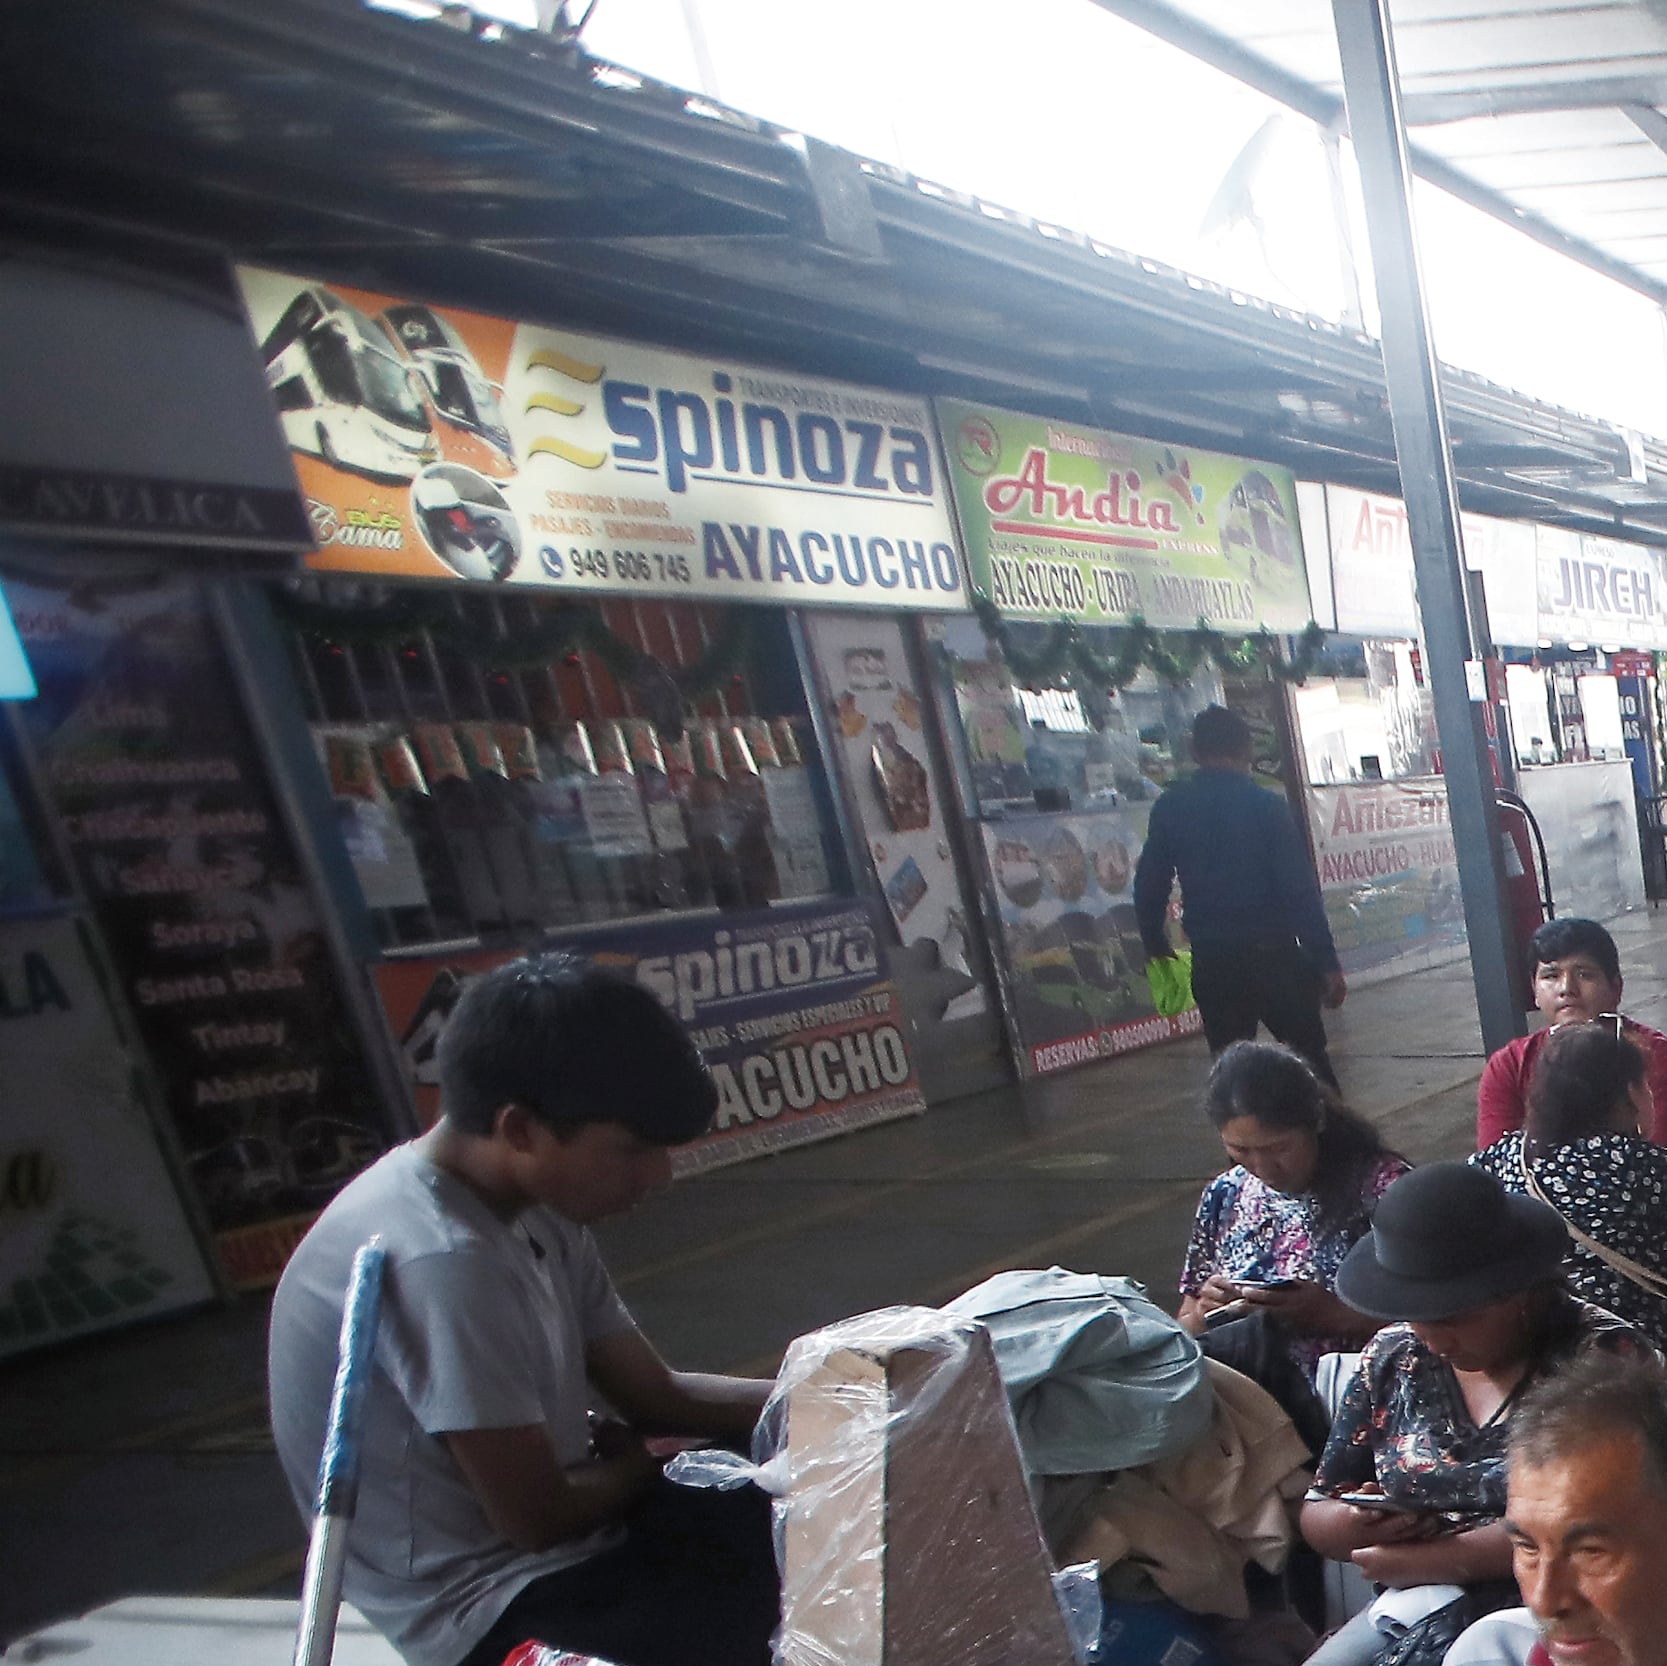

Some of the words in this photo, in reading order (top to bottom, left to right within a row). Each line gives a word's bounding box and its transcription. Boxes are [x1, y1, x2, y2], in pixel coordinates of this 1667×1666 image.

[985, 446, 1181, 533] Andia
[569, 547, 608, 579] 949
[613, 549, 649, 581] 606
[653, 551, 691, 583] 745
[701, 521, 961, 593] AYACUCHO
[989, 554, 1087, 612] AYACUCHO
[1553, 556, 1656, 618] JIREH
[1321, 846, 1409, 885] AYACUCHO
[196, 1065, 320, 1105] Abancay
